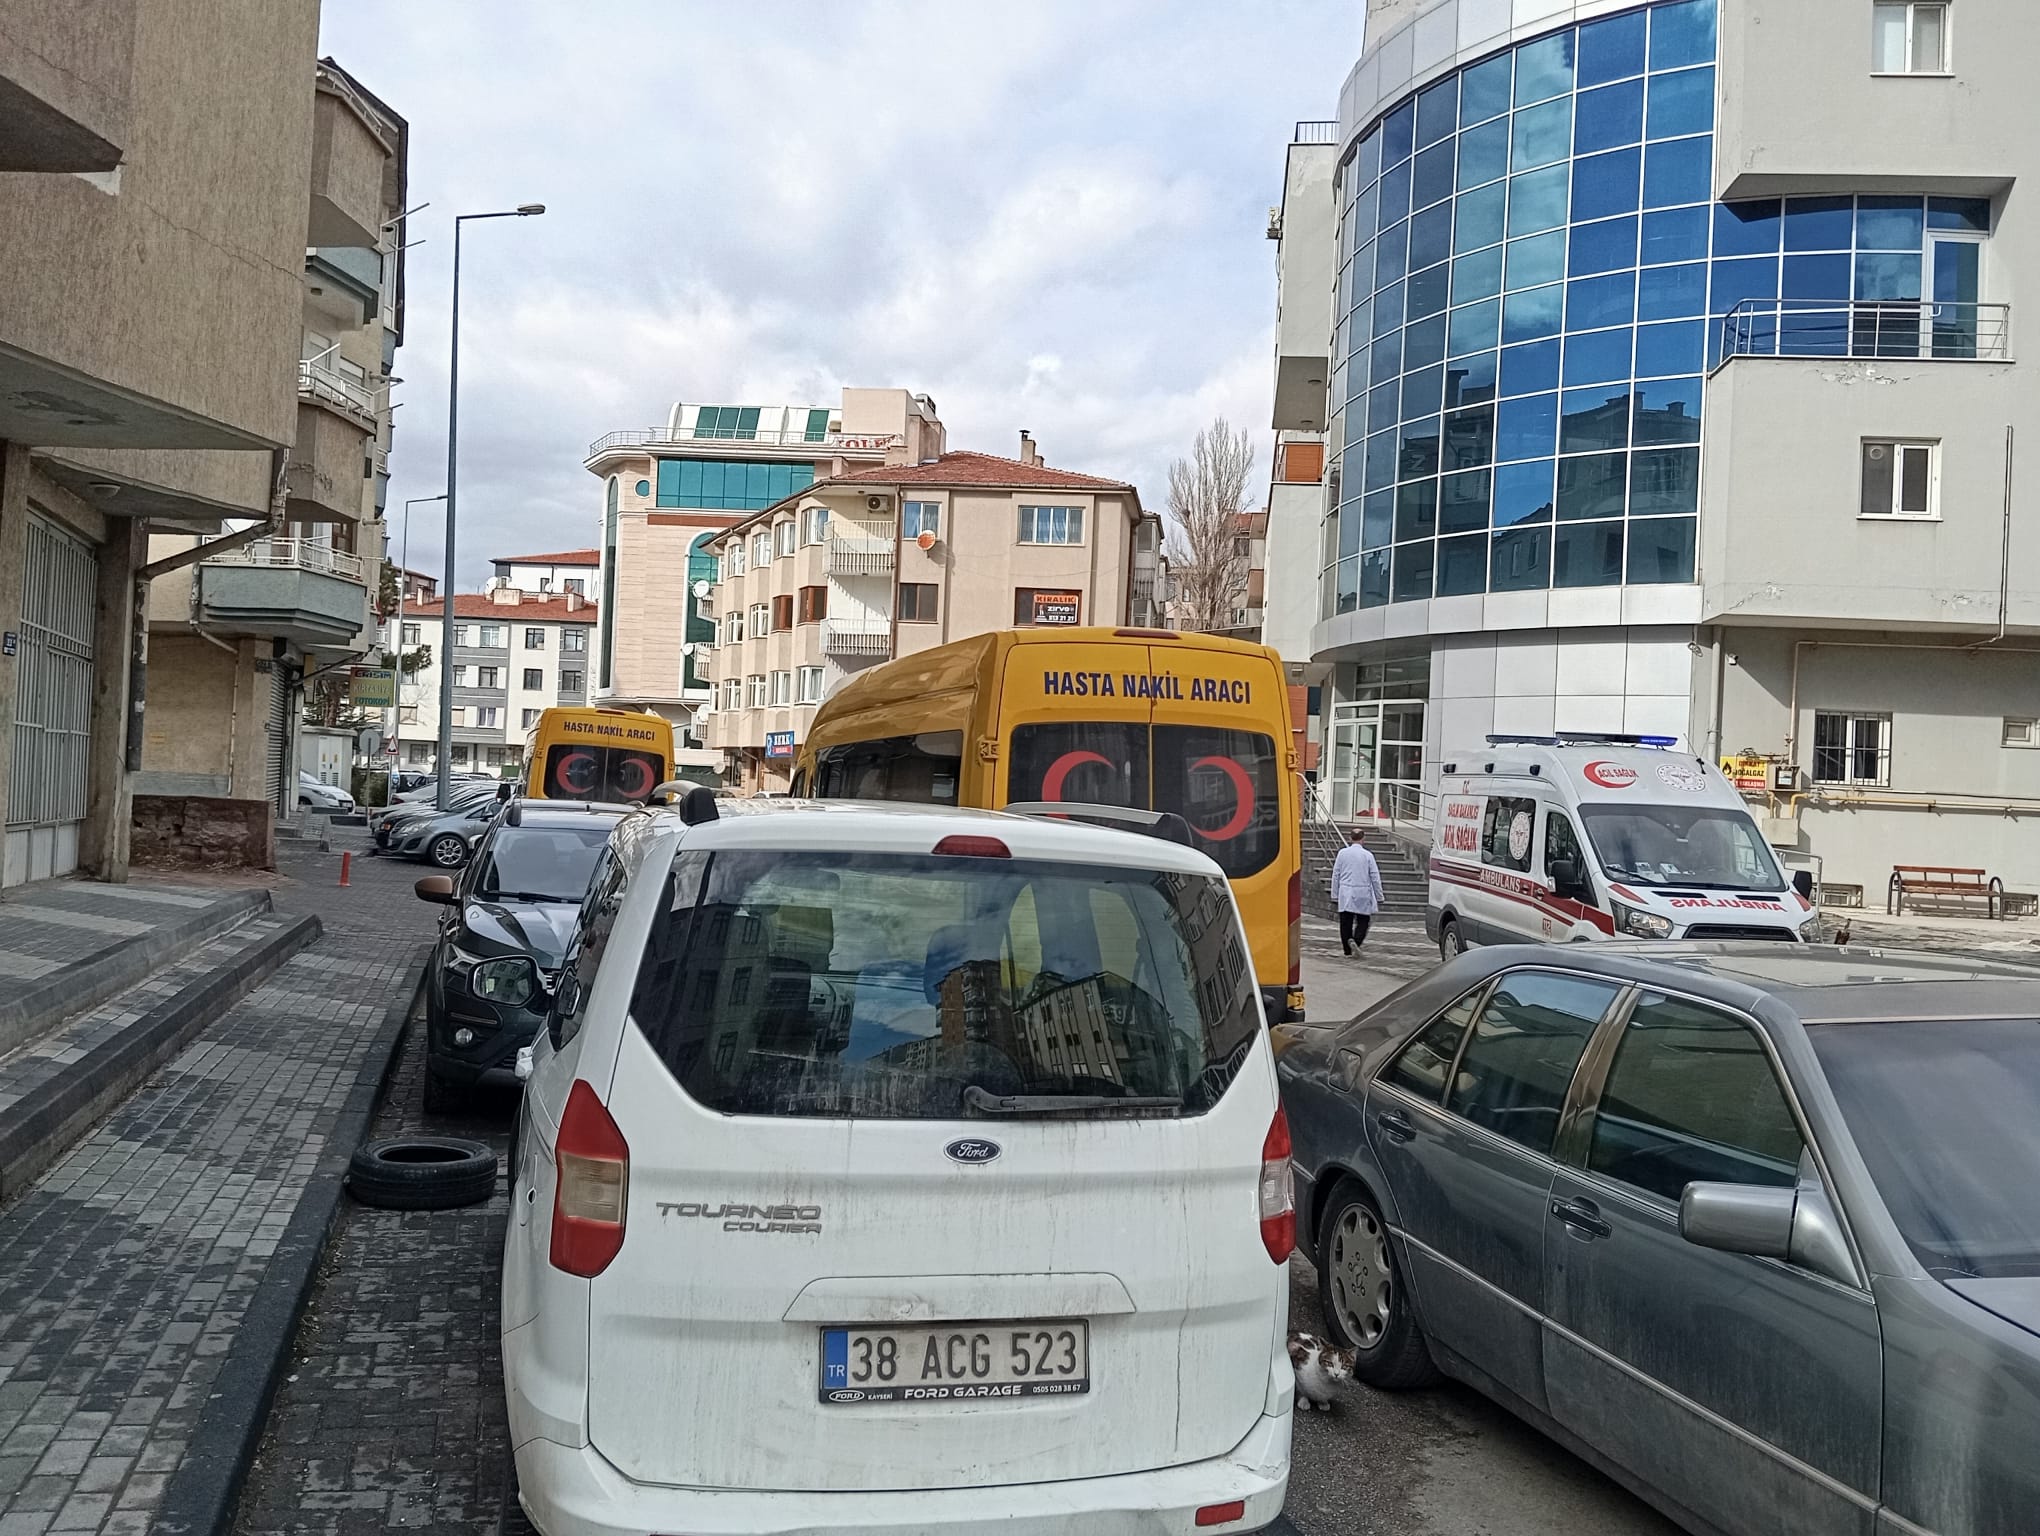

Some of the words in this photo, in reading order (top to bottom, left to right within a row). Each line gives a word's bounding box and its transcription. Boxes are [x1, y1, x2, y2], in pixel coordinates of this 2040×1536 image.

[1044, 671, 1115, 697] HASTA
[1123, 670, 1184, 700] NAKİL
[1190, 678, 1251, 705] ARACI
[564, 721, 594, 734] HASTA
[597, 724, 624, 737] NAKİL
[626, 728, 656, 741] ARACI
[1480, 868, 1521, 893] AMBULANS
[957, 1142, 989, 1158] Ford
[656, 1202, 822, 1220] TOURNEO
[723, 1221, 822, 1233] COURIER
[852, 1336, 897, 1382] 38
[921, 1333, 990, 1379] ACG
[1011, 1331, 1077, 1376] 523
[828, 1365, 845, 1378] TR
[835, 1392, 861, 1400] FORD
[904, 1388, 949, 1399] FORD
[954, 1385, 1022, 1397] GARAGE
